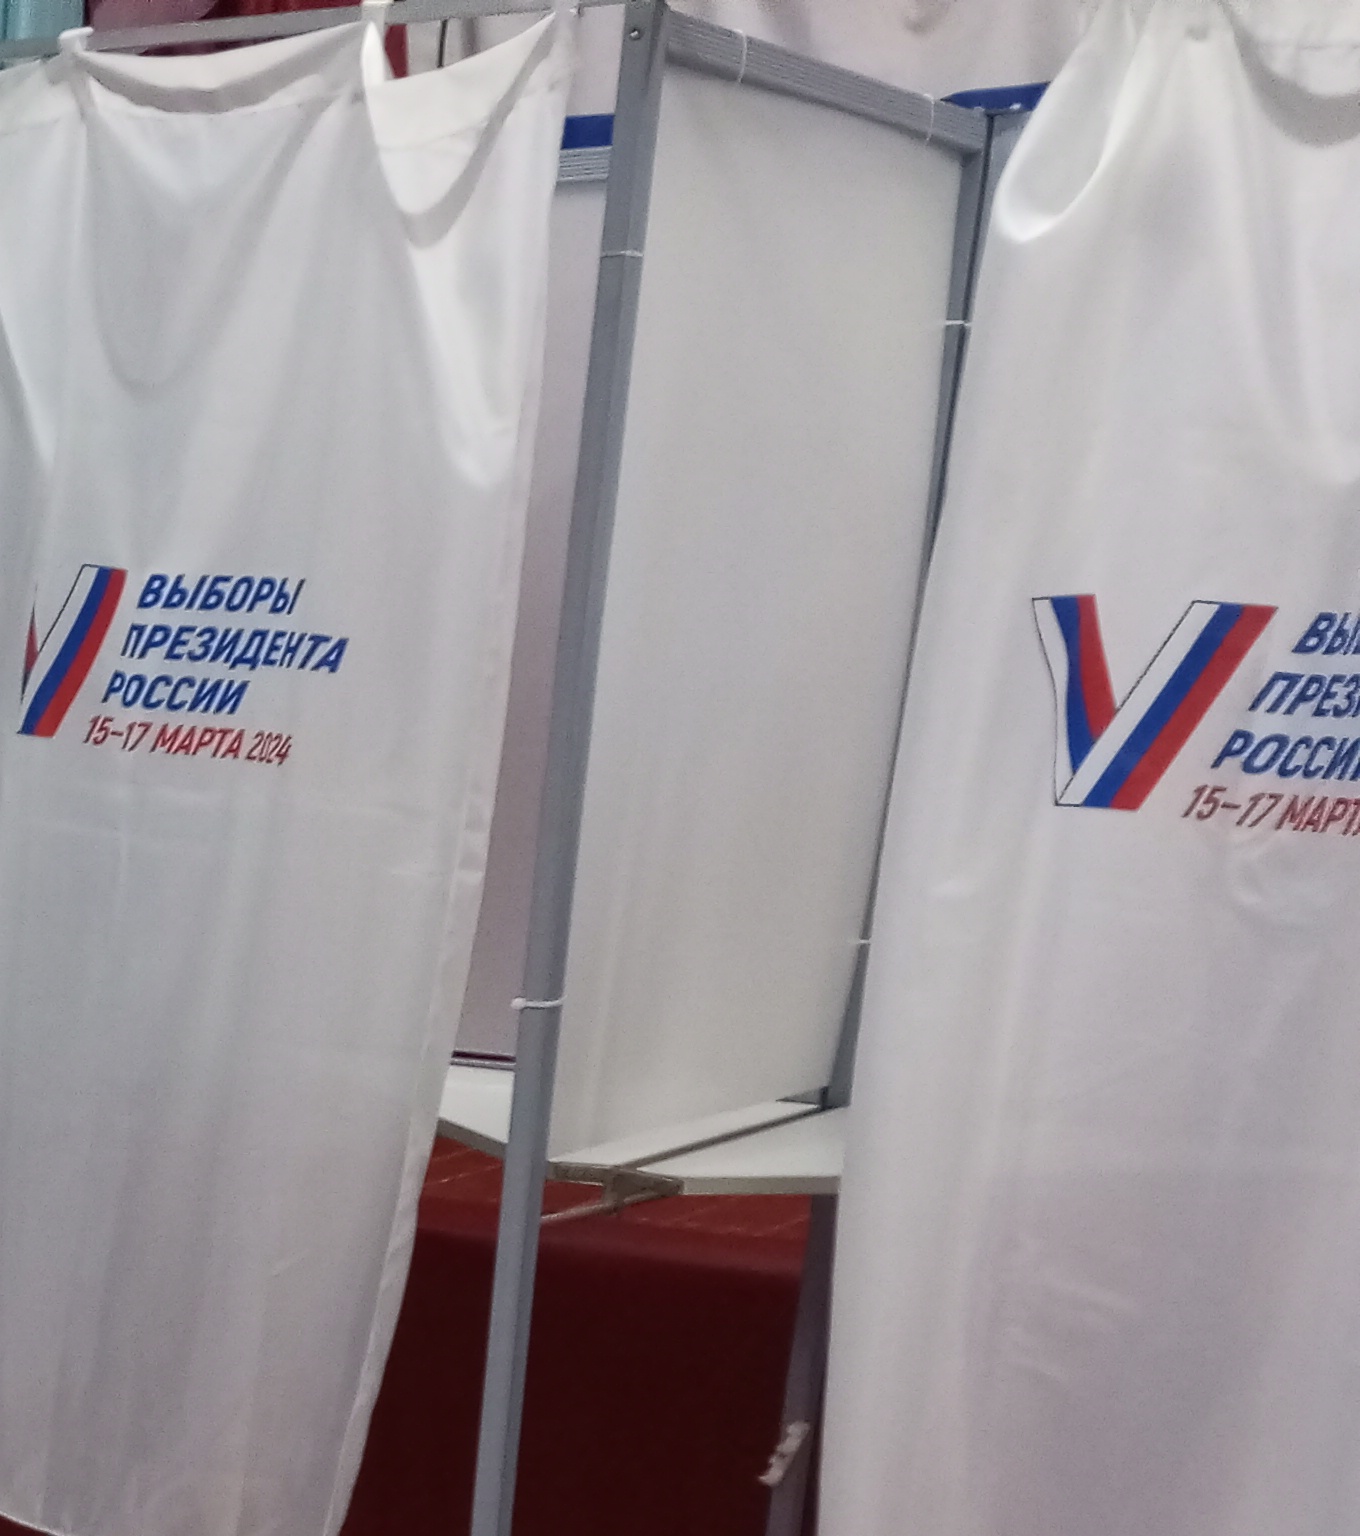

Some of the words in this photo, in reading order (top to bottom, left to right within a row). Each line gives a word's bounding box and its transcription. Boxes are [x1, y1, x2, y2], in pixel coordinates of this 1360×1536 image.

[136, 573, 306, 615] ВЫБОРЫ
[120, 623, 350, 674] ПРЕЗИДЕНТА
[1290, 611, 1360, 655] ВЫ
[101, 670, 251, 715] РОССИИ
[1248, 670, 1360, 718] ПРЕЗ
[151, 723, 246, 760] МАРТА
[245, 731, 293, 766] 2024
[1274, 794, 1360, 836] МАРТ
